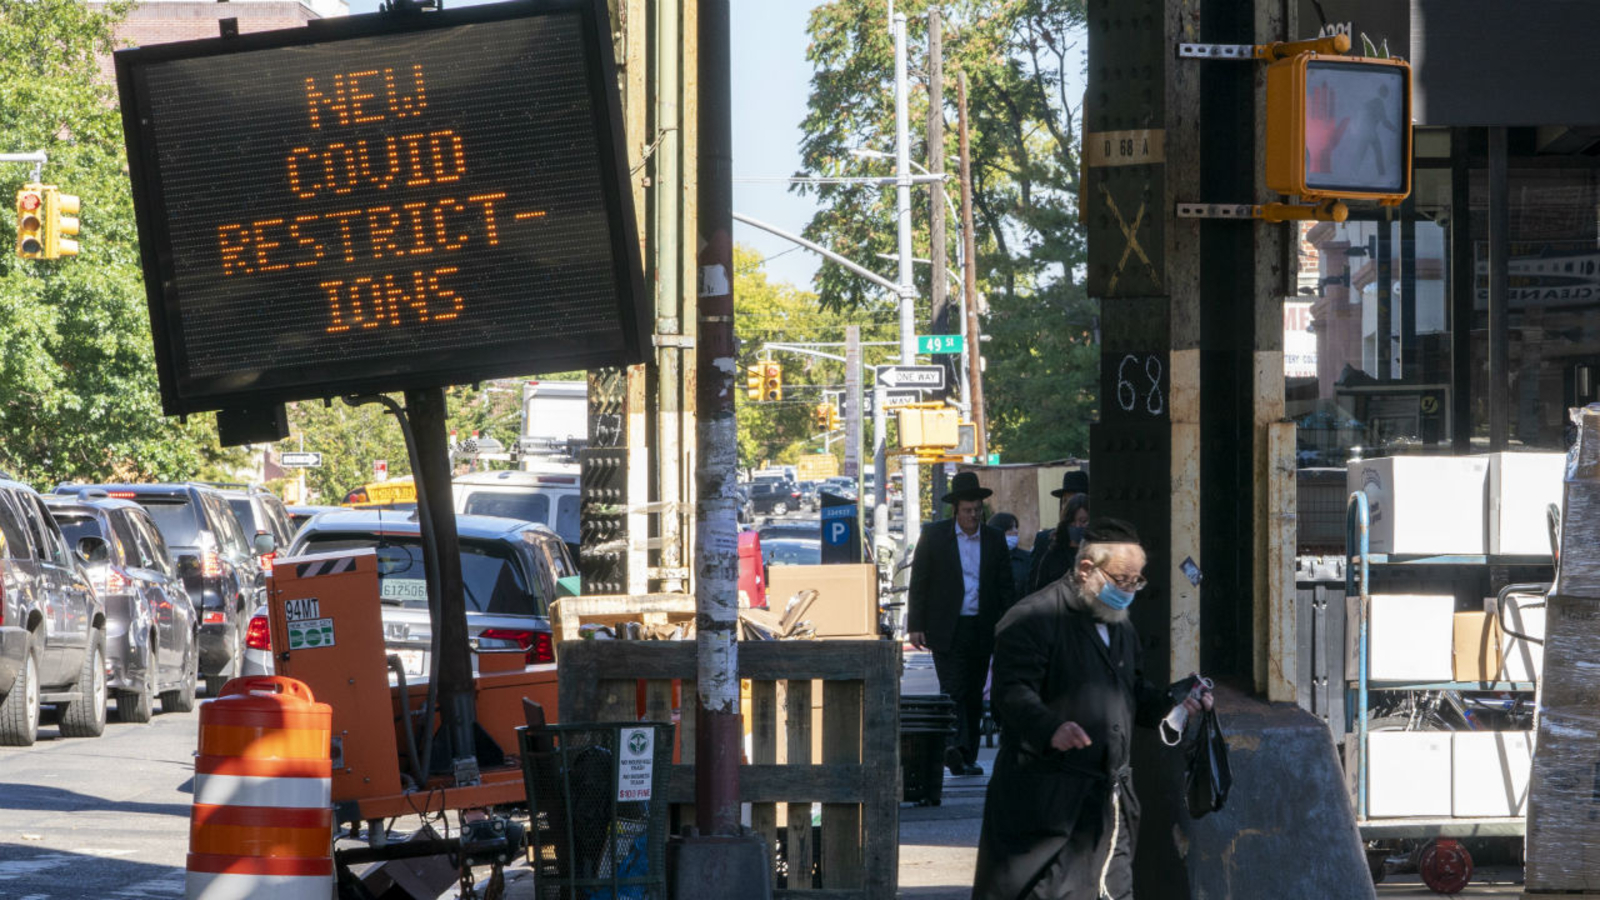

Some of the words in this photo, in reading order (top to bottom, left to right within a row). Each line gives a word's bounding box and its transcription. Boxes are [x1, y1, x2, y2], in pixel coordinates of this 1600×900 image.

[306, 64, 426, 128] NEW
[1120, 139, 1133, 156] 68
[1142, 139, 1149, 155] A
[287, 130, 465, 198] COVID
[218, 193, 546, 275] RESTRICT-
[320, 267, 464, 332] IONS
[926, 337, 942, 352] 49
[896, 372, 915, 382] ONE
[918, 372, 936, 381] WAY
[1118, 354, 1163, 415] 68
[832, 522, 846, 543] P
[384, 584, 428, 597] 612506
[285, 598, 319, 621] 94MT
[290, 627, 332, 647] DOT
